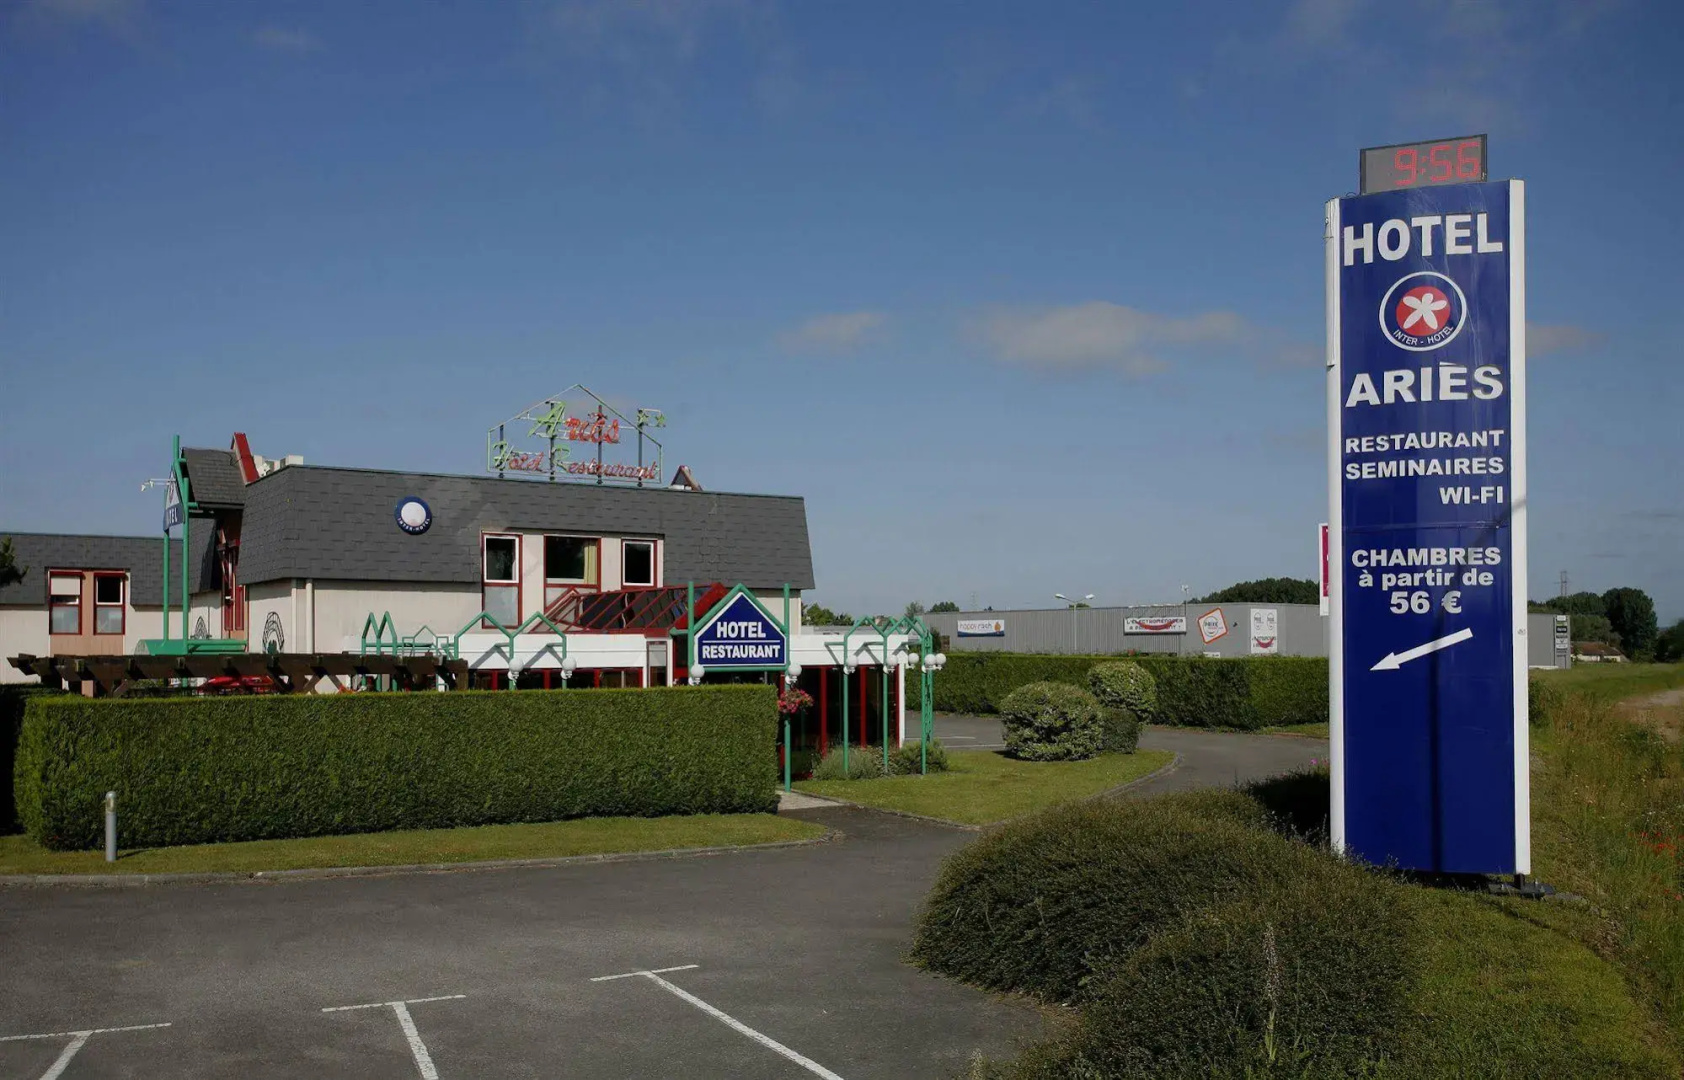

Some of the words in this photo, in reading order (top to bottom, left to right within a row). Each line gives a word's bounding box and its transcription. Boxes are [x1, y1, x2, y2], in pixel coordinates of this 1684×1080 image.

[1394, 141, 1481, 186] 9:56
[1344, 213, 1503, 266] HOTEL
[1393, 328, 1418, 346] INTER
[1427, 325, 1454, 345] HOTEL
[1345, 361, 1504, 408] ARIÈS
[1345, 430, 1504, 454] RESTAURANT
[1345, 457, 1504, 480] SEMINAIRES
[1439, 486, 1504, 505] WI-FI
[1351, 547, 1501, 568] CHAMBRES
[1358, 570, 1373, 587] à
[1382, 569, 1455, 590] partir
[1462, 568, 1494, 587] de
[1390, 591, 1430, 614] 56
[1441, 591, 1462, 614] €
[716, 621, 766, 638] HOTEL
[702, 645, 781, 659] RESTAURANT
